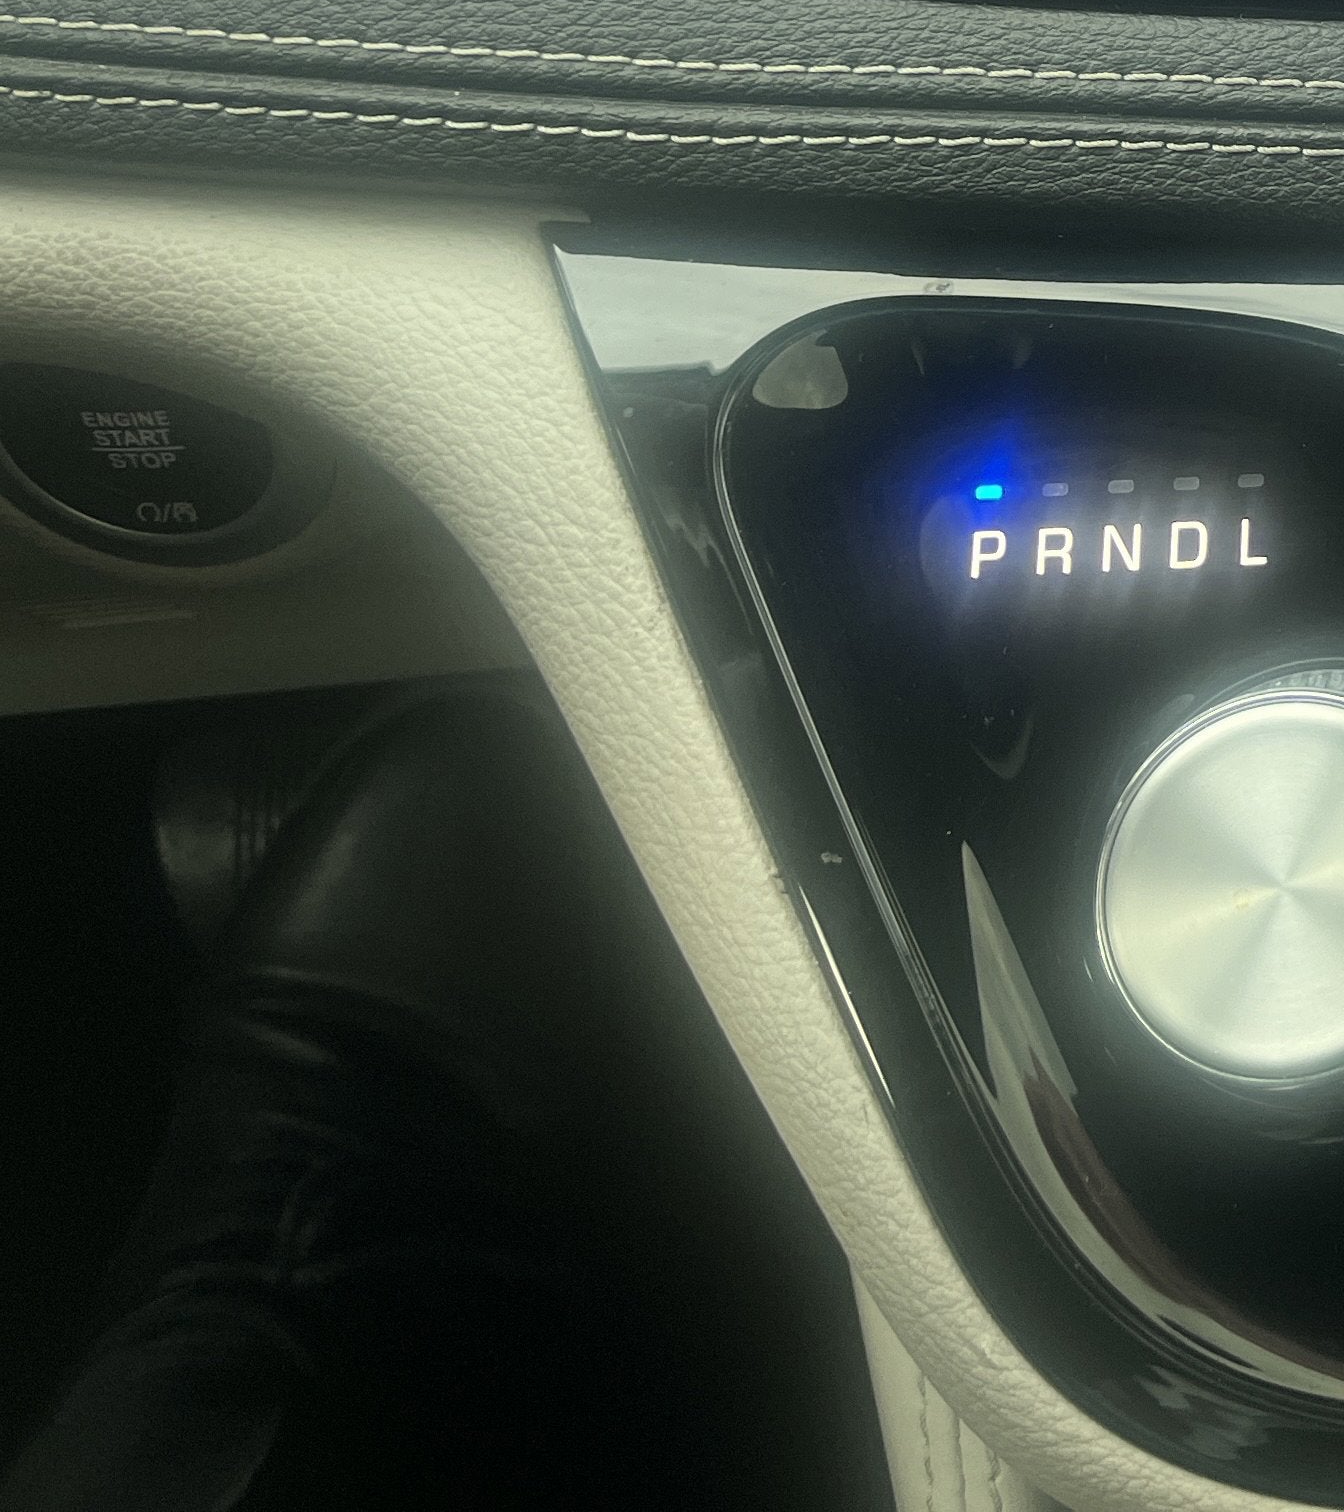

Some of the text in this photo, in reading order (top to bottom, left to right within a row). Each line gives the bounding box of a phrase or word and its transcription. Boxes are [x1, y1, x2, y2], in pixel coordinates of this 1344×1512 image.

[80, 409, 171, 428] ENGINE
[92, 428, 171, 447] START
[107, 452, 177, 470] STOP
